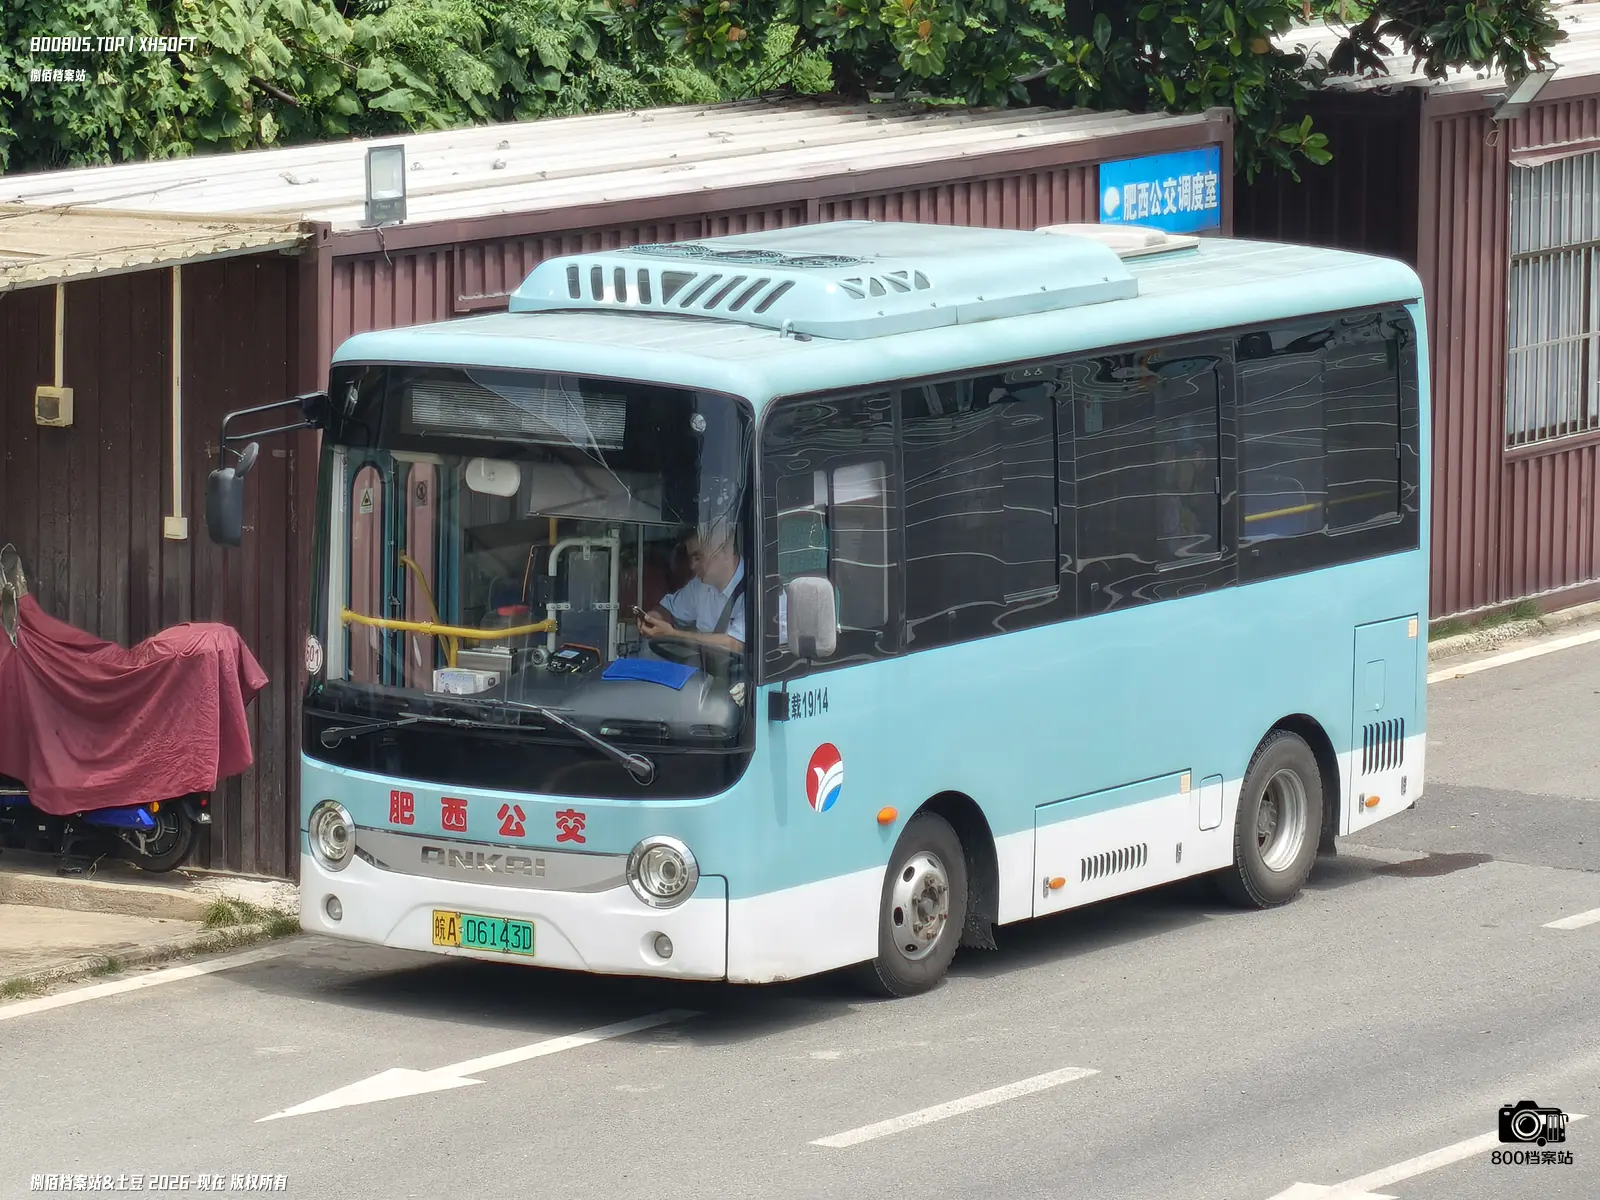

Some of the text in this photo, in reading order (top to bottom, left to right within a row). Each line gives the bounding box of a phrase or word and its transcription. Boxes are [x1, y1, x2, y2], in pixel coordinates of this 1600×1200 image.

[1123, 170, 1218, 221] 肥西公交调度室
[787, 687, 829, 720] 载19/14
[388, 789, 587, 844] 肥西公交
[421, 846, 546, 877] ANKAI
